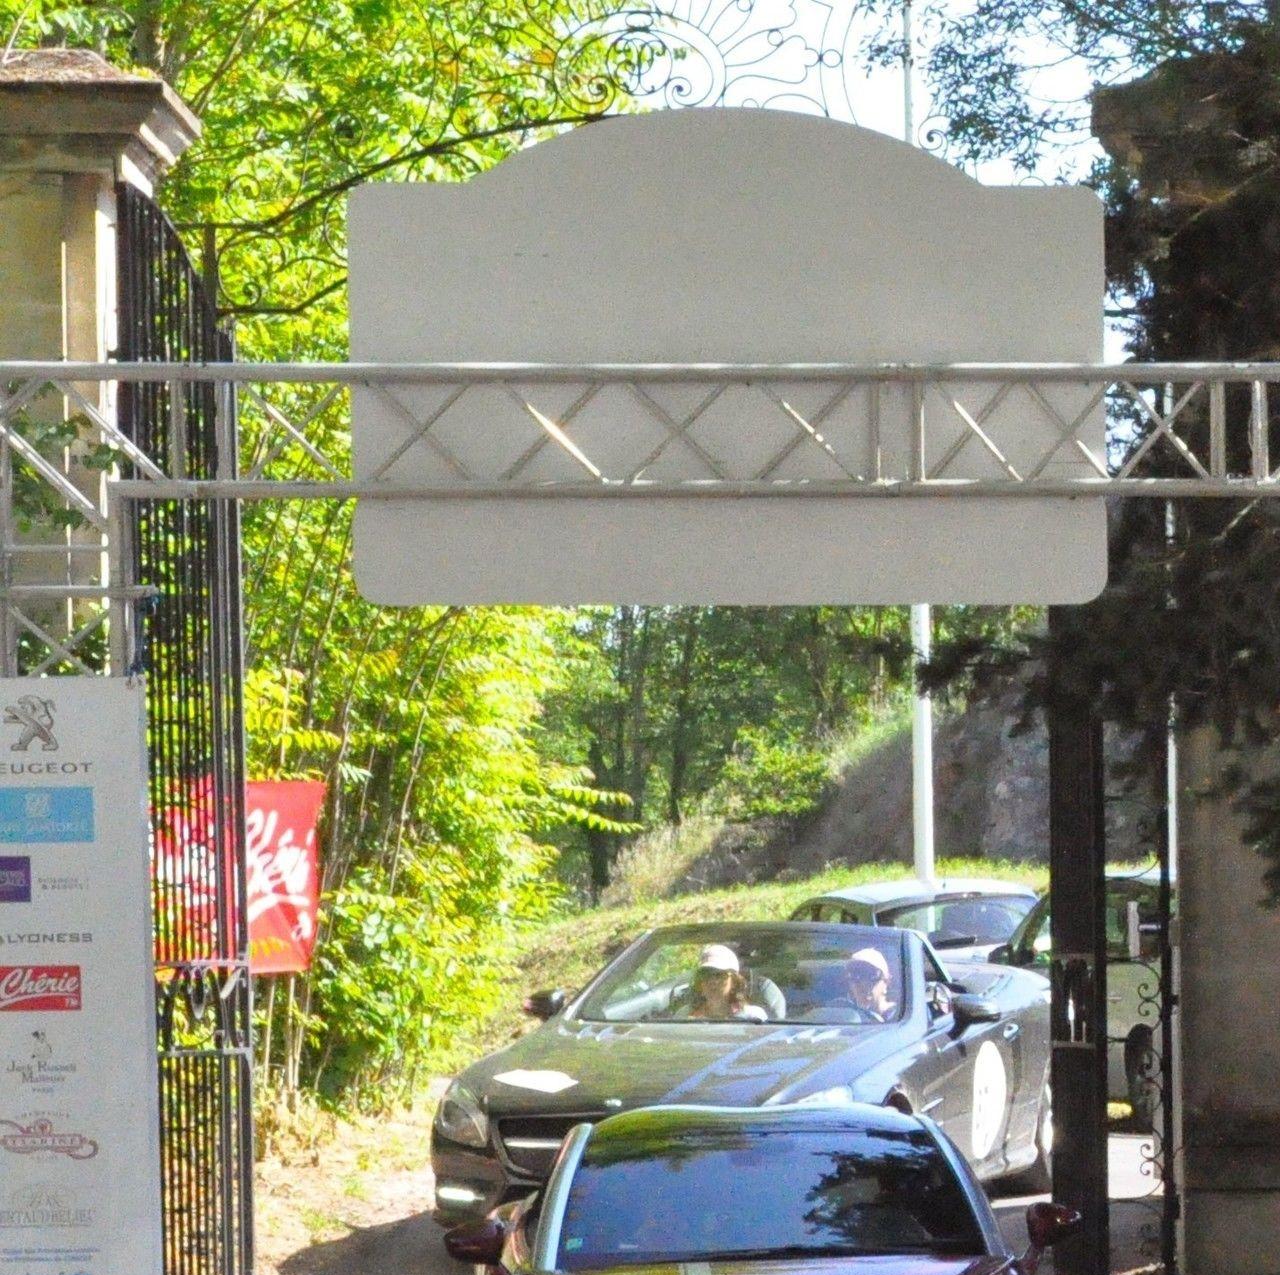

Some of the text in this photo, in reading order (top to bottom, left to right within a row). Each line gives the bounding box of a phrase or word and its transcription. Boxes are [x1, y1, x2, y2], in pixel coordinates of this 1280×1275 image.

[0, 762, 93, 774] EUGEOT
[7, 932, 93, 943] LYONESS
[0, 967, 80, 1000] Chérie
